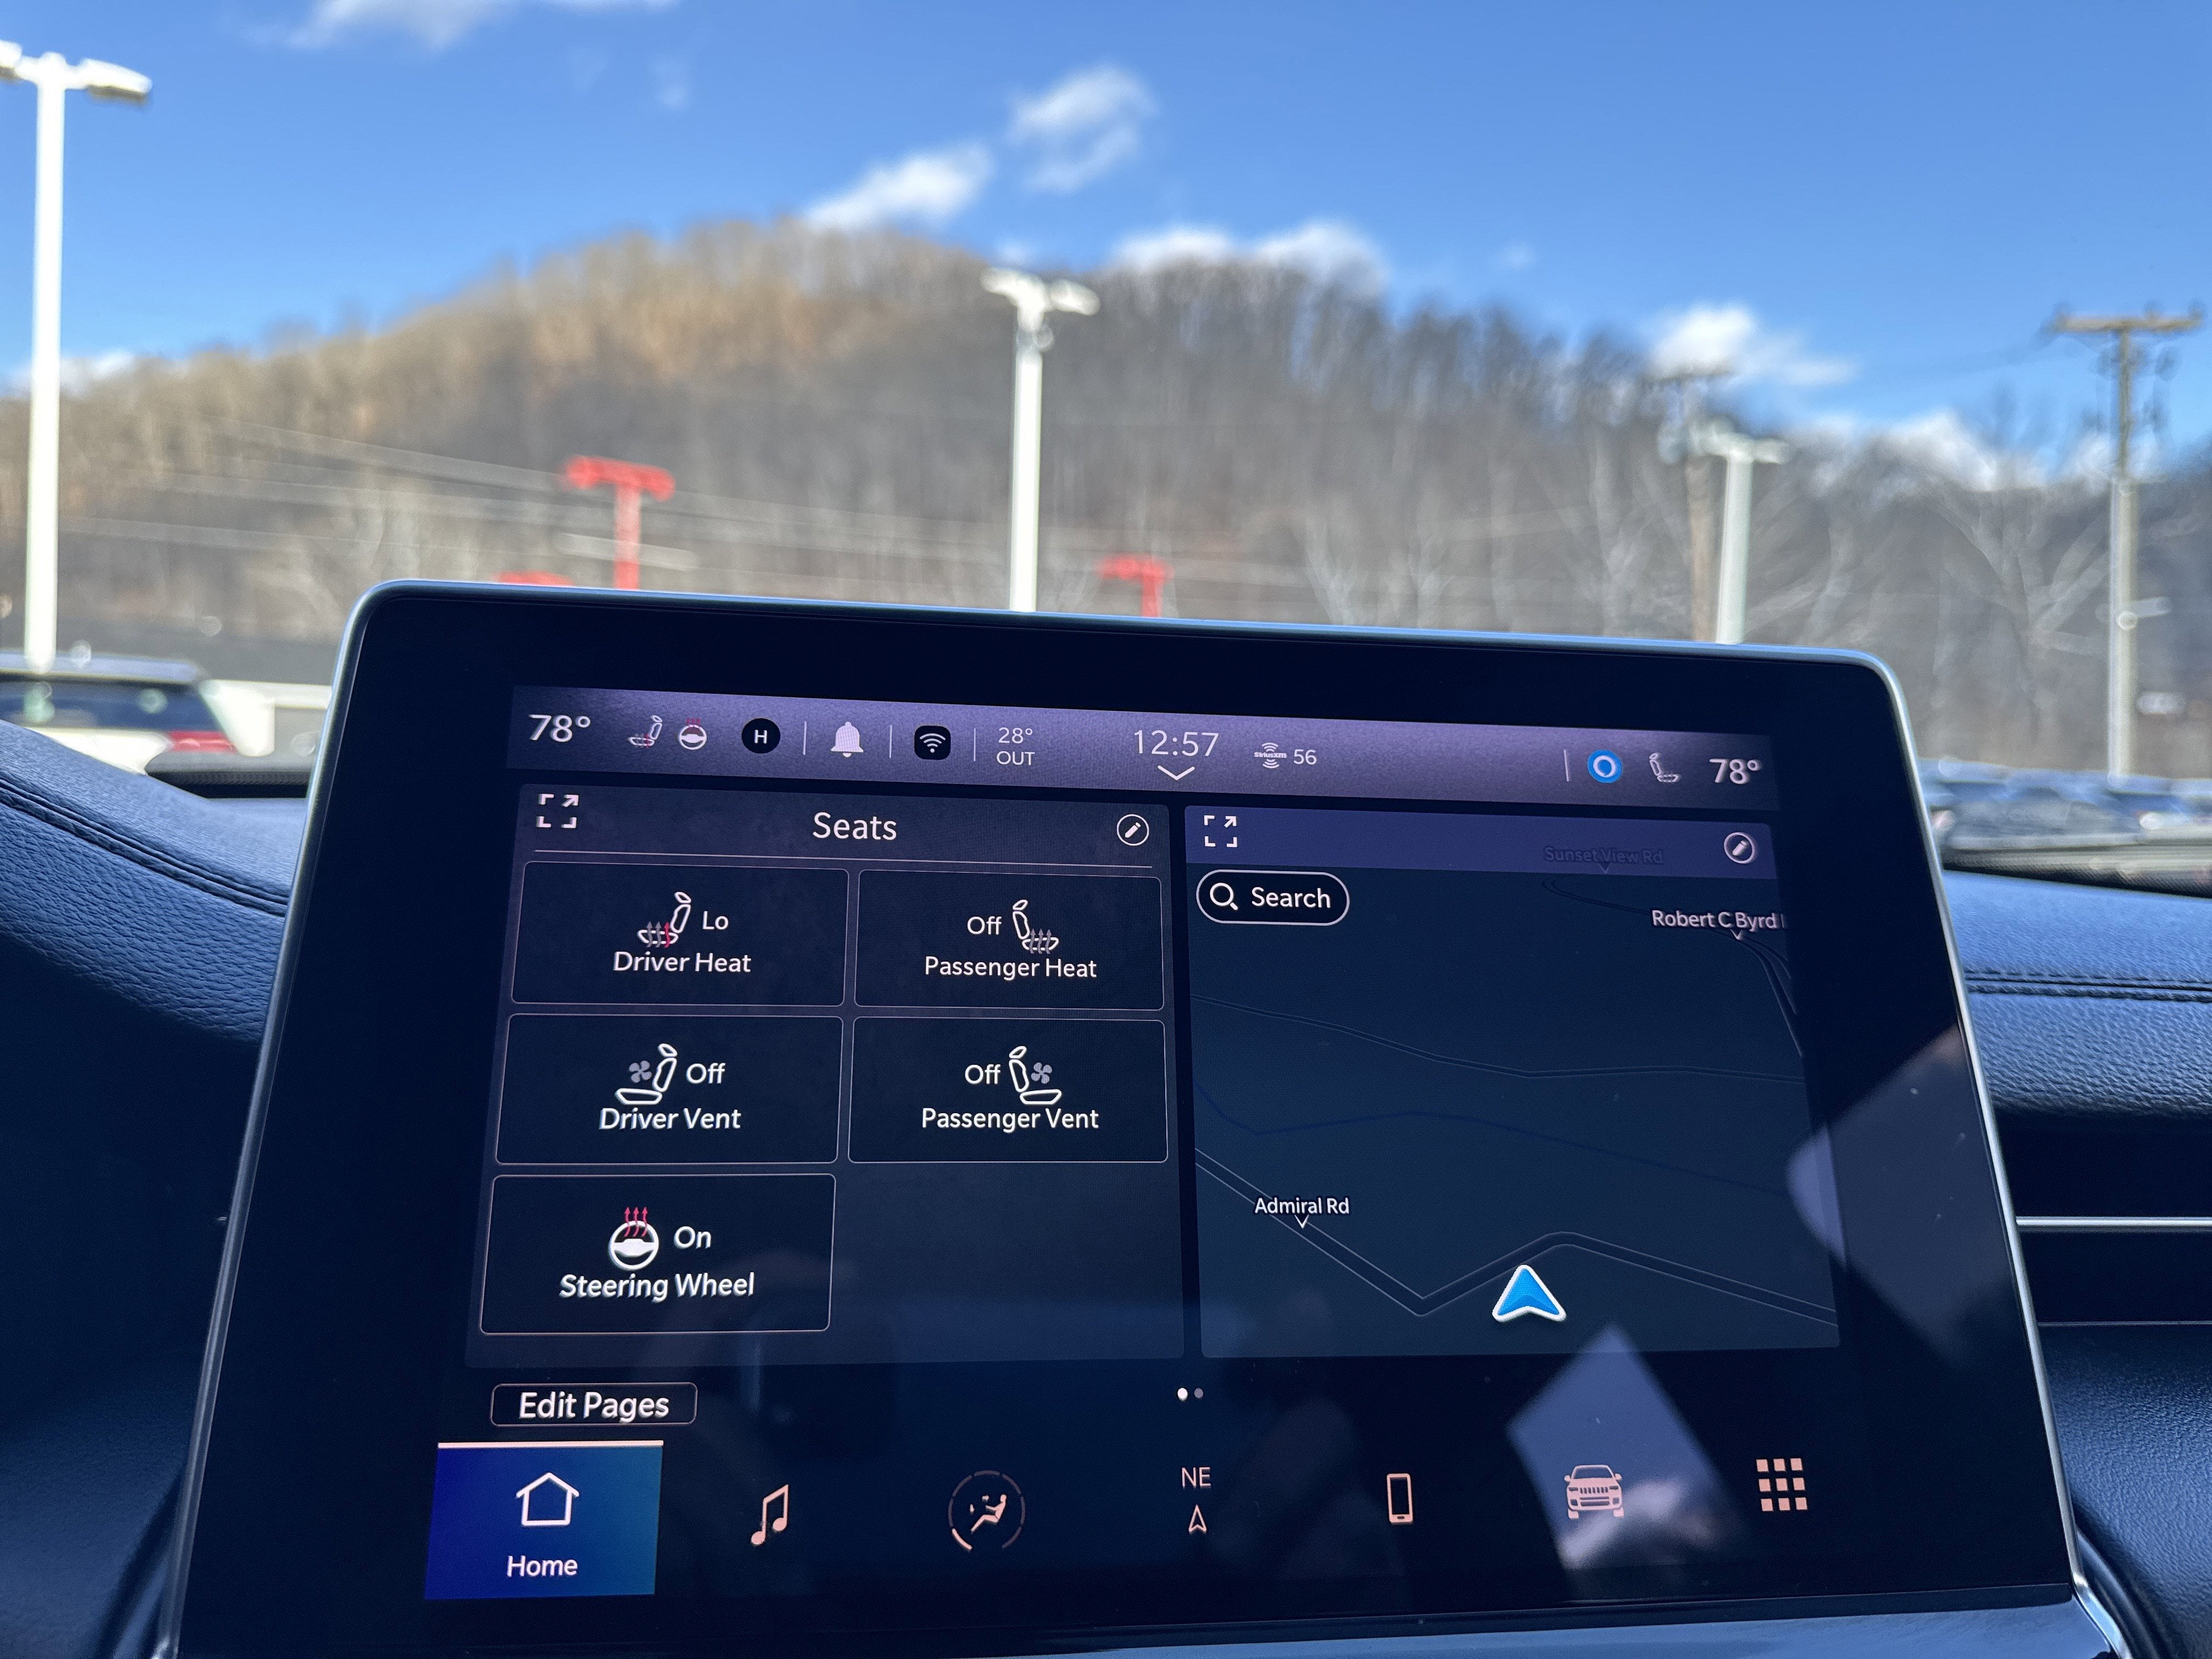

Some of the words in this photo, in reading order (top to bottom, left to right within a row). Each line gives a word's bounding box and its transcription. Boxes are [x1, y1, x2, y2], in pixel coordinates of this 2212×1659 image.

[529, 714, 591, 742] 78°
[754, 729, 768, 744] H
[997, 726, 1034, 744] 28°
[1133, 729, 1220, 757] 12:57
[996, 750, 1036, 766] OUT
[1293, 748, 1318, 766] 56
[1709, 758, 1761, 785] 78°
[812, 811, 898, 841] Seats
[1544, 847, 1599, 864] Sunset
[1600, 849, 1639, 864] View
[1643, 849, 1663, 864] Rd
[1251, 886, 1331, 909] Search
[702, 910, 729, 930] Lo
[967, 915, 1002, 935] Off
[1651, 910, 1716, 928] Robert
[1718, 911, 1733, 928] C
[1735, 912, 1778, 933] Byrd
[613, 951, 690, 972] Driver
[694, 953, 752, 973] Heat
[925, 956, 1041, 981] Passenger
[1046, 958, 1097, 978] Heat
[686, 1062, 726, 1085] Off
[964, 1063, 1002, 1085] Off
[599, 1107, 678, 1130] Driver
[683, 1107, 742, 1130] Vent
[922, 1107, 1041, 1133] Passenger
[1045, 1108, 1099, 1129] Vent
[1254, 1197, 1322, 1215] Admiral
[1326, 1197, 1350, 1215] Rd
[673, 1225, 712, 1249] On
[558, 1273, 669, 1303] Steering
[674, 1271, 755, 1297] Wheel
[519, 1390, 578, 1419] Edit
[583, 1391, 669, 1423] Pages
[1181, 1466, 1212, 1488] NE
[506, 1554, 578, 1578] Home
